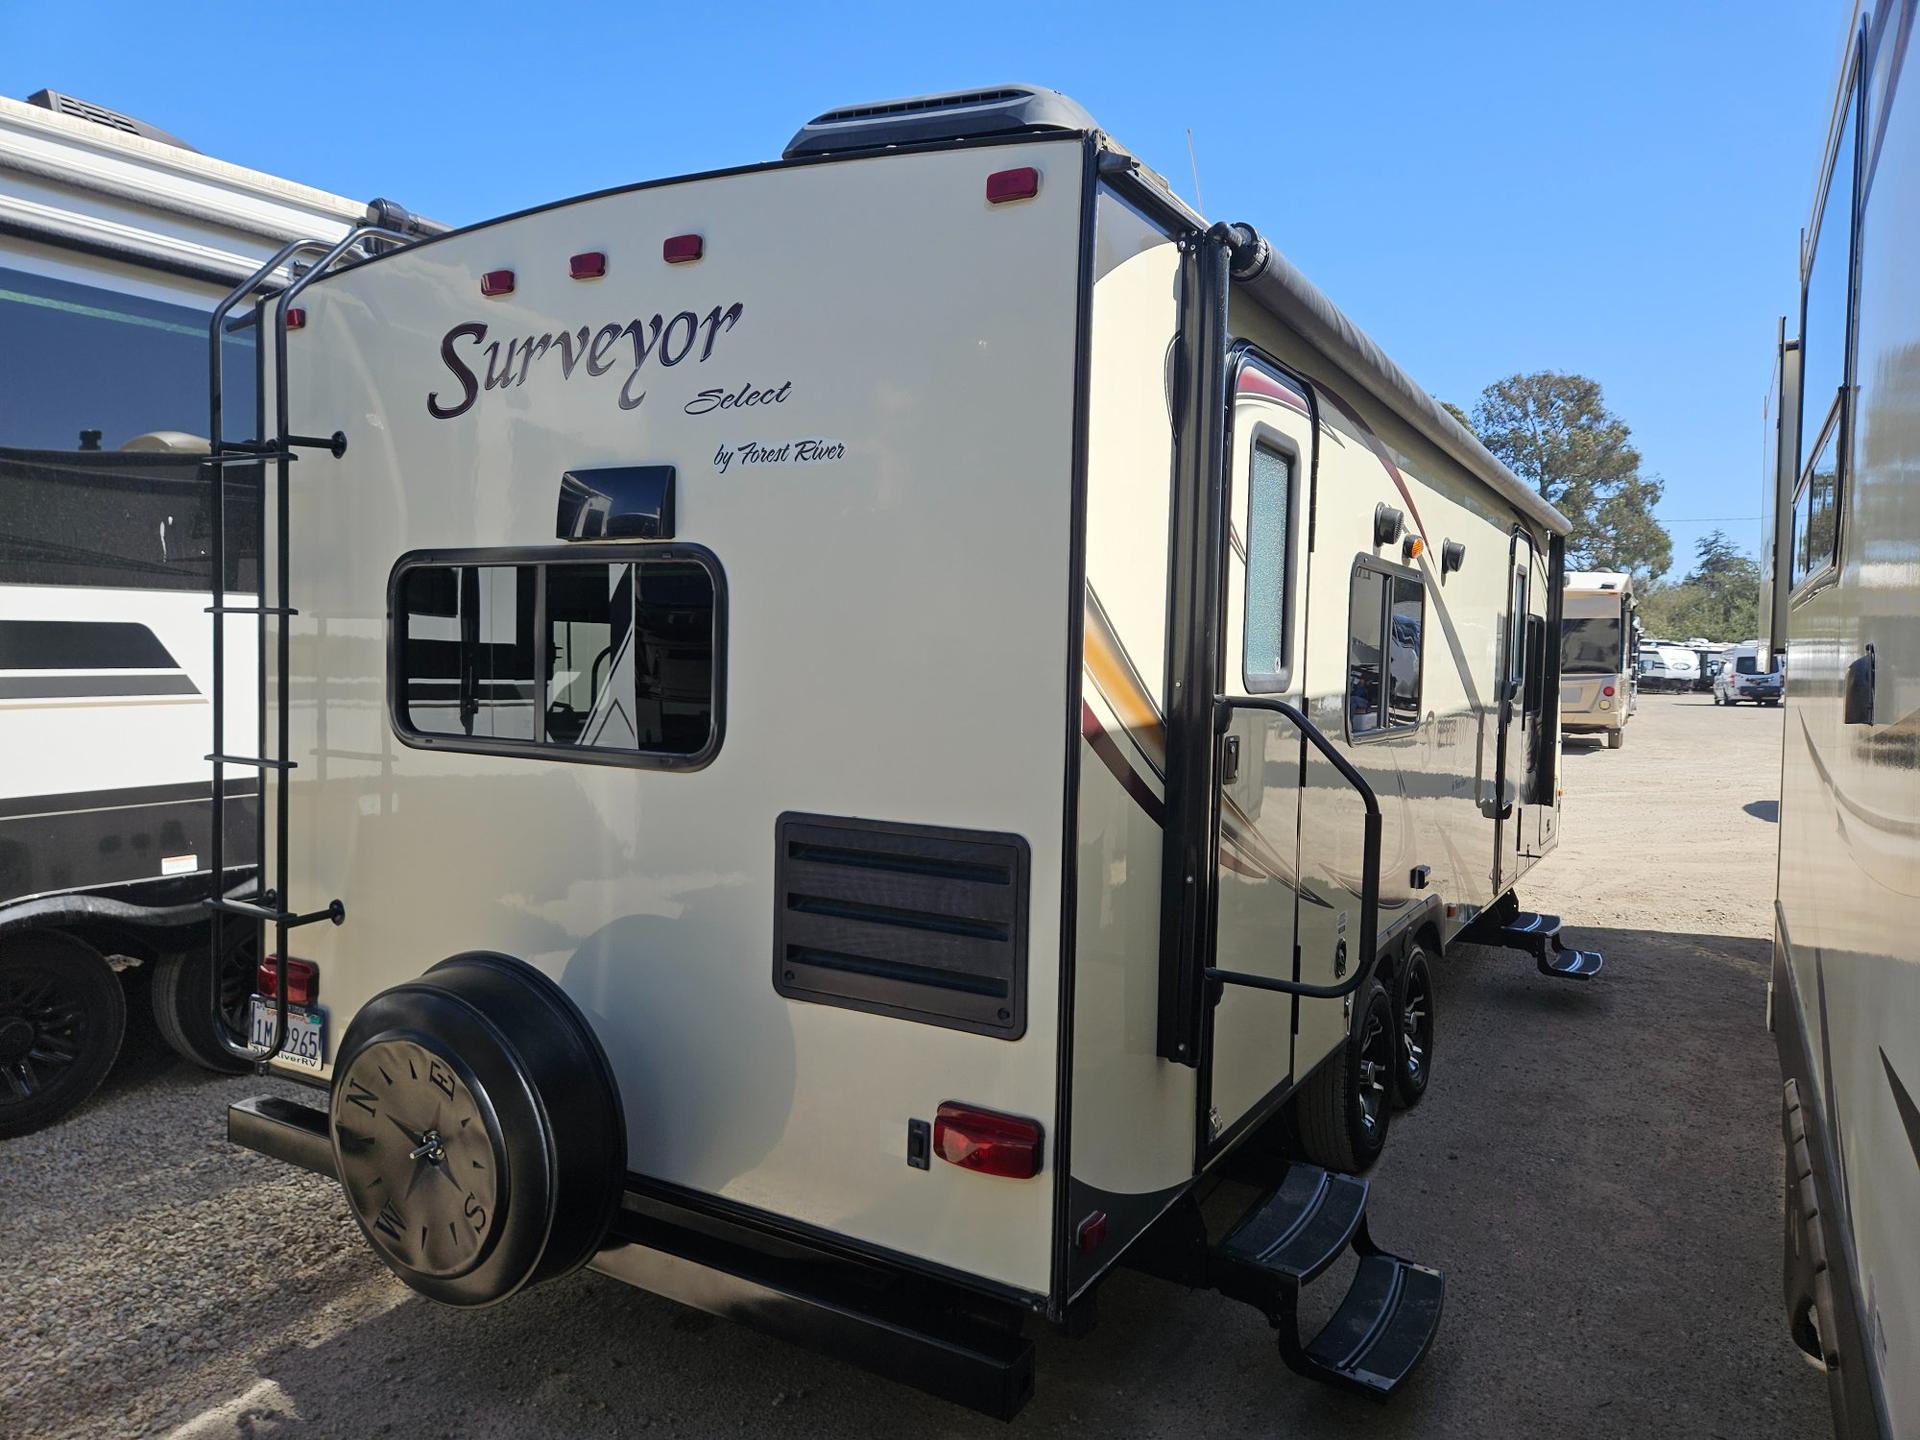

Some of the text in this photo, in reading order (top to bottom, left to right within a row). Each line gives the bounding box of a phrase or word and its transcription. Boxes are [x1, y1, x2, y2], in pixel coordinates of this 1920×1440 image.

[427, 301, 744, 420] Surveyor
[684, 381, 792, 415] Select
[713, 439, 845, 474] by Forest River
[255, 1018, 317, 1059] 1M965
[346, 1079, 379, 1117] N
[429, 1060, 456, 1102] E
[373, 1197, 410, 1242] W
[464, 1191, 487, 1234] S
